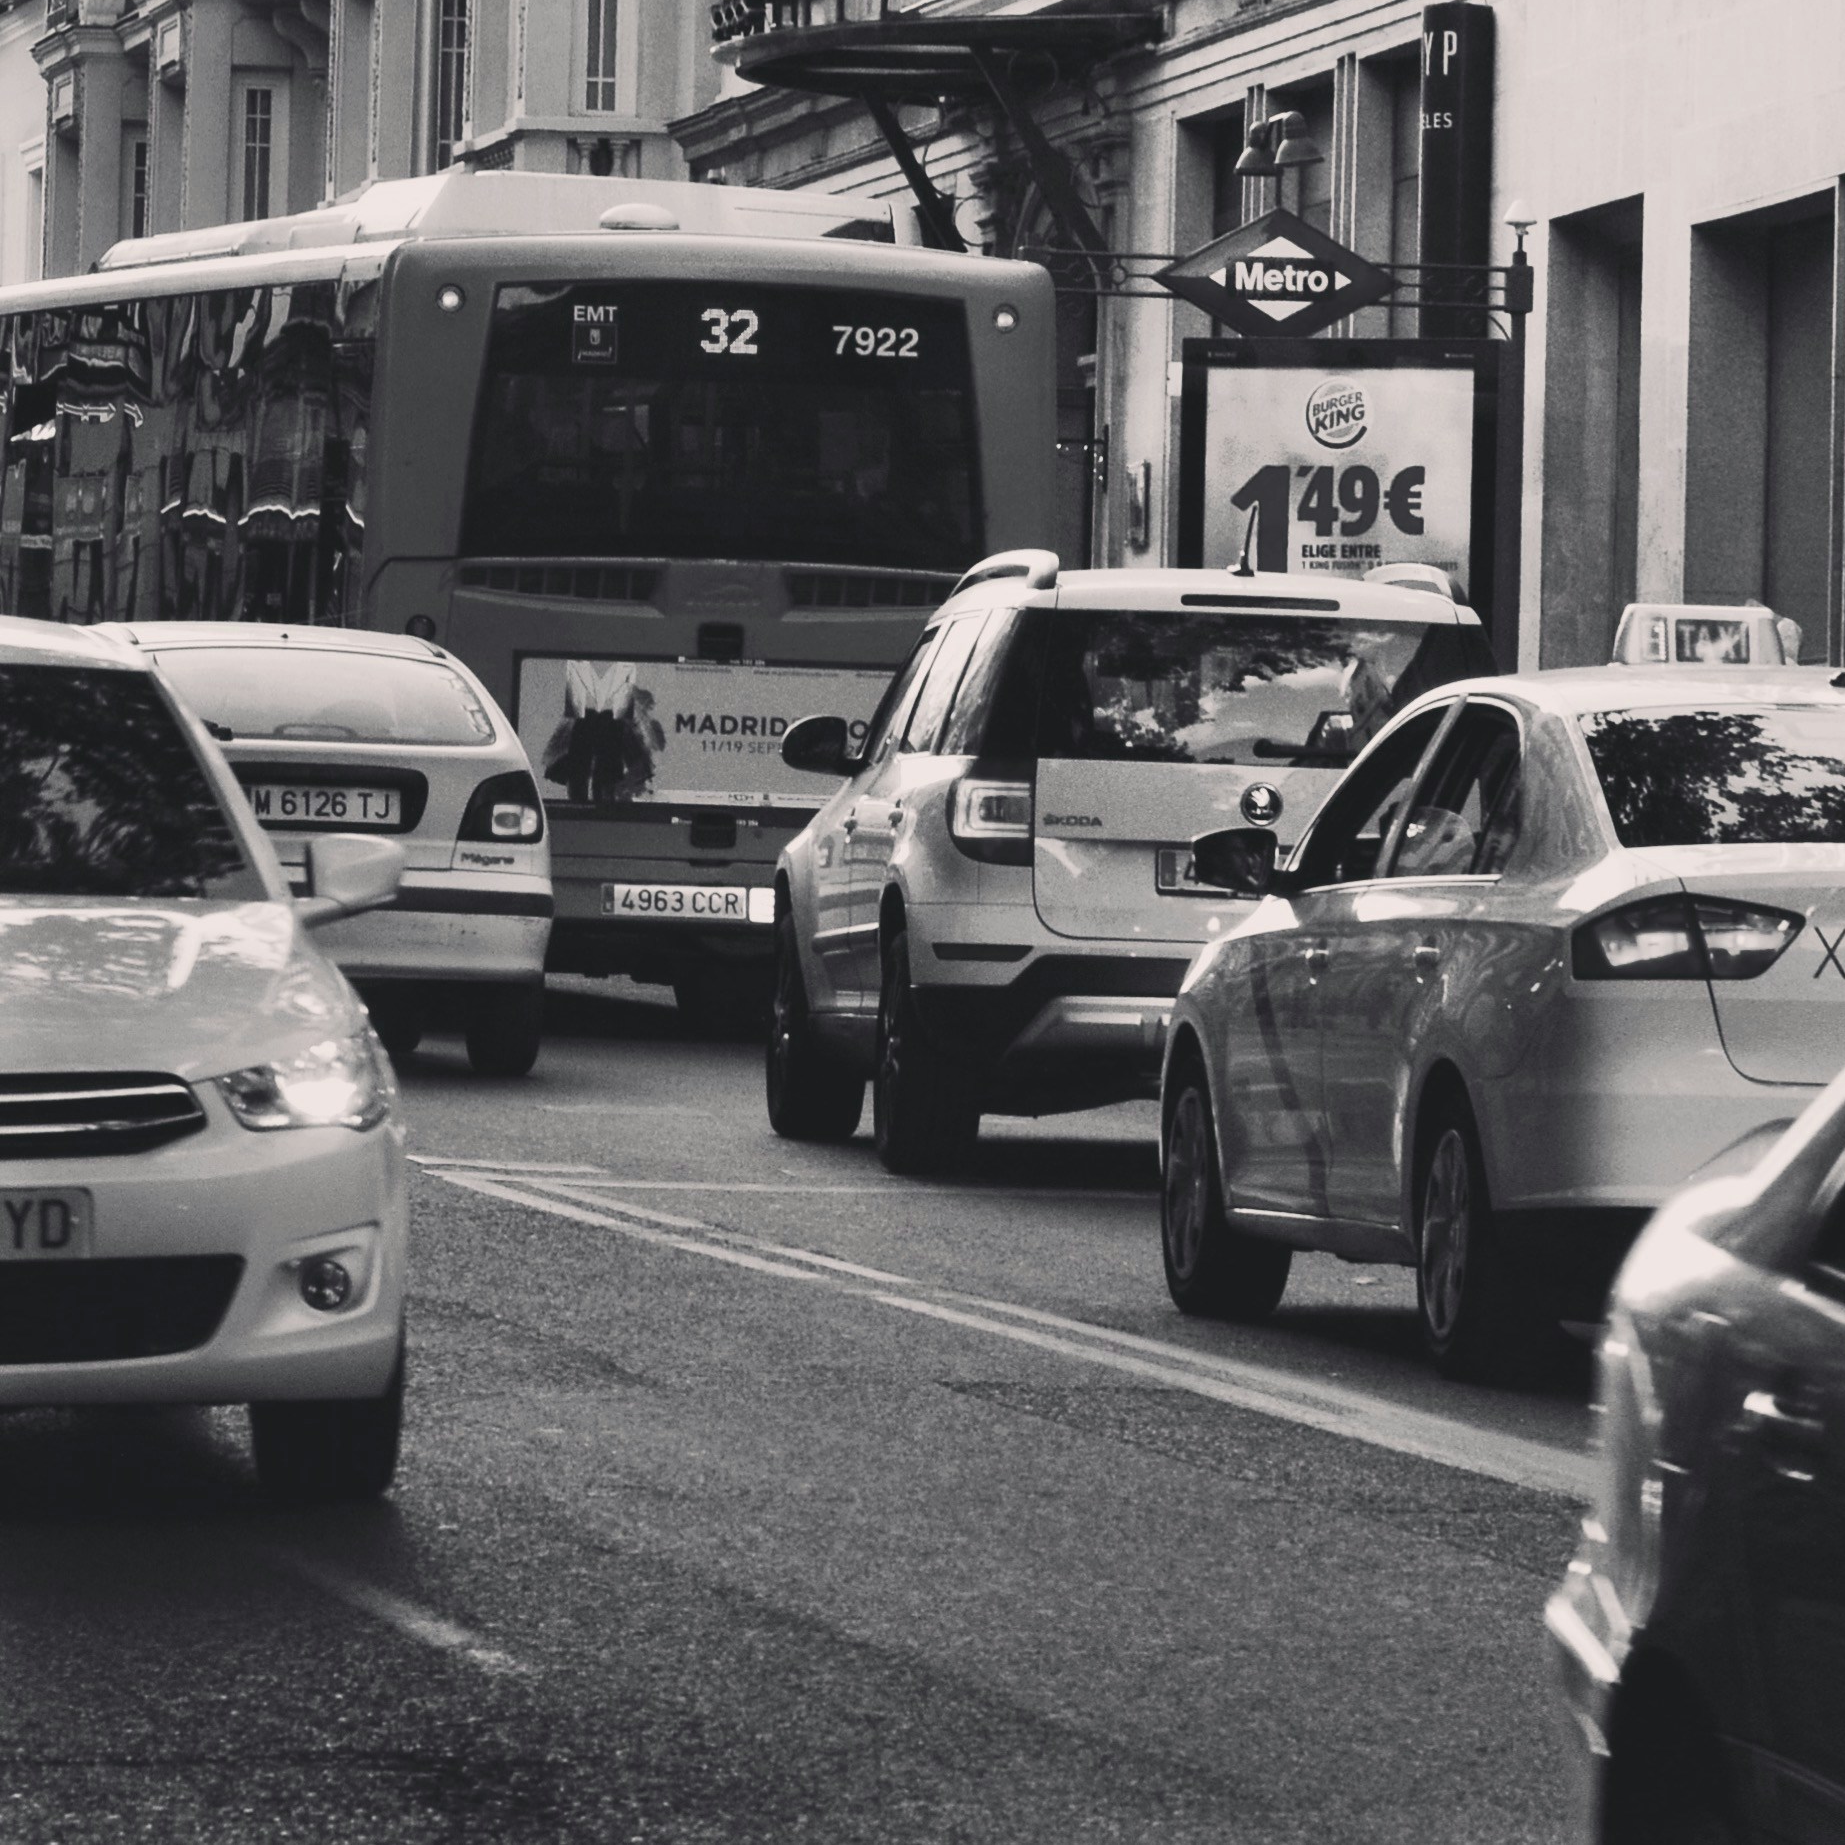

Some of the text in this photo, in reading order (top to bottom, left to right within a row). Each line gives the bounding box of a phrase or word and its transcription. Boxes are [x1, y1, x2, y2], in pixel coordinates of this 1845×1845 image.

[1235, 261, 1329, 293] Metro
[574, 305, 618, 322] EMT
[700, 308, 758, 354] 32
[832, 325, 920, 358] 7922
[1312, 391, 1363, 417] BURGER
[1314, 405, 1365, 435] KING
[1301, 544, 1381, 559] ELIGE ENTRE
[1678, 622, 1749, 660] TAXI
[701, 740, 743, 754] 11/19
[254, 789, 391, 819] M 6126 TJ
[621, 888, 739, 915] 4963 CCR
[4, 1198, 71, 1250] YD
